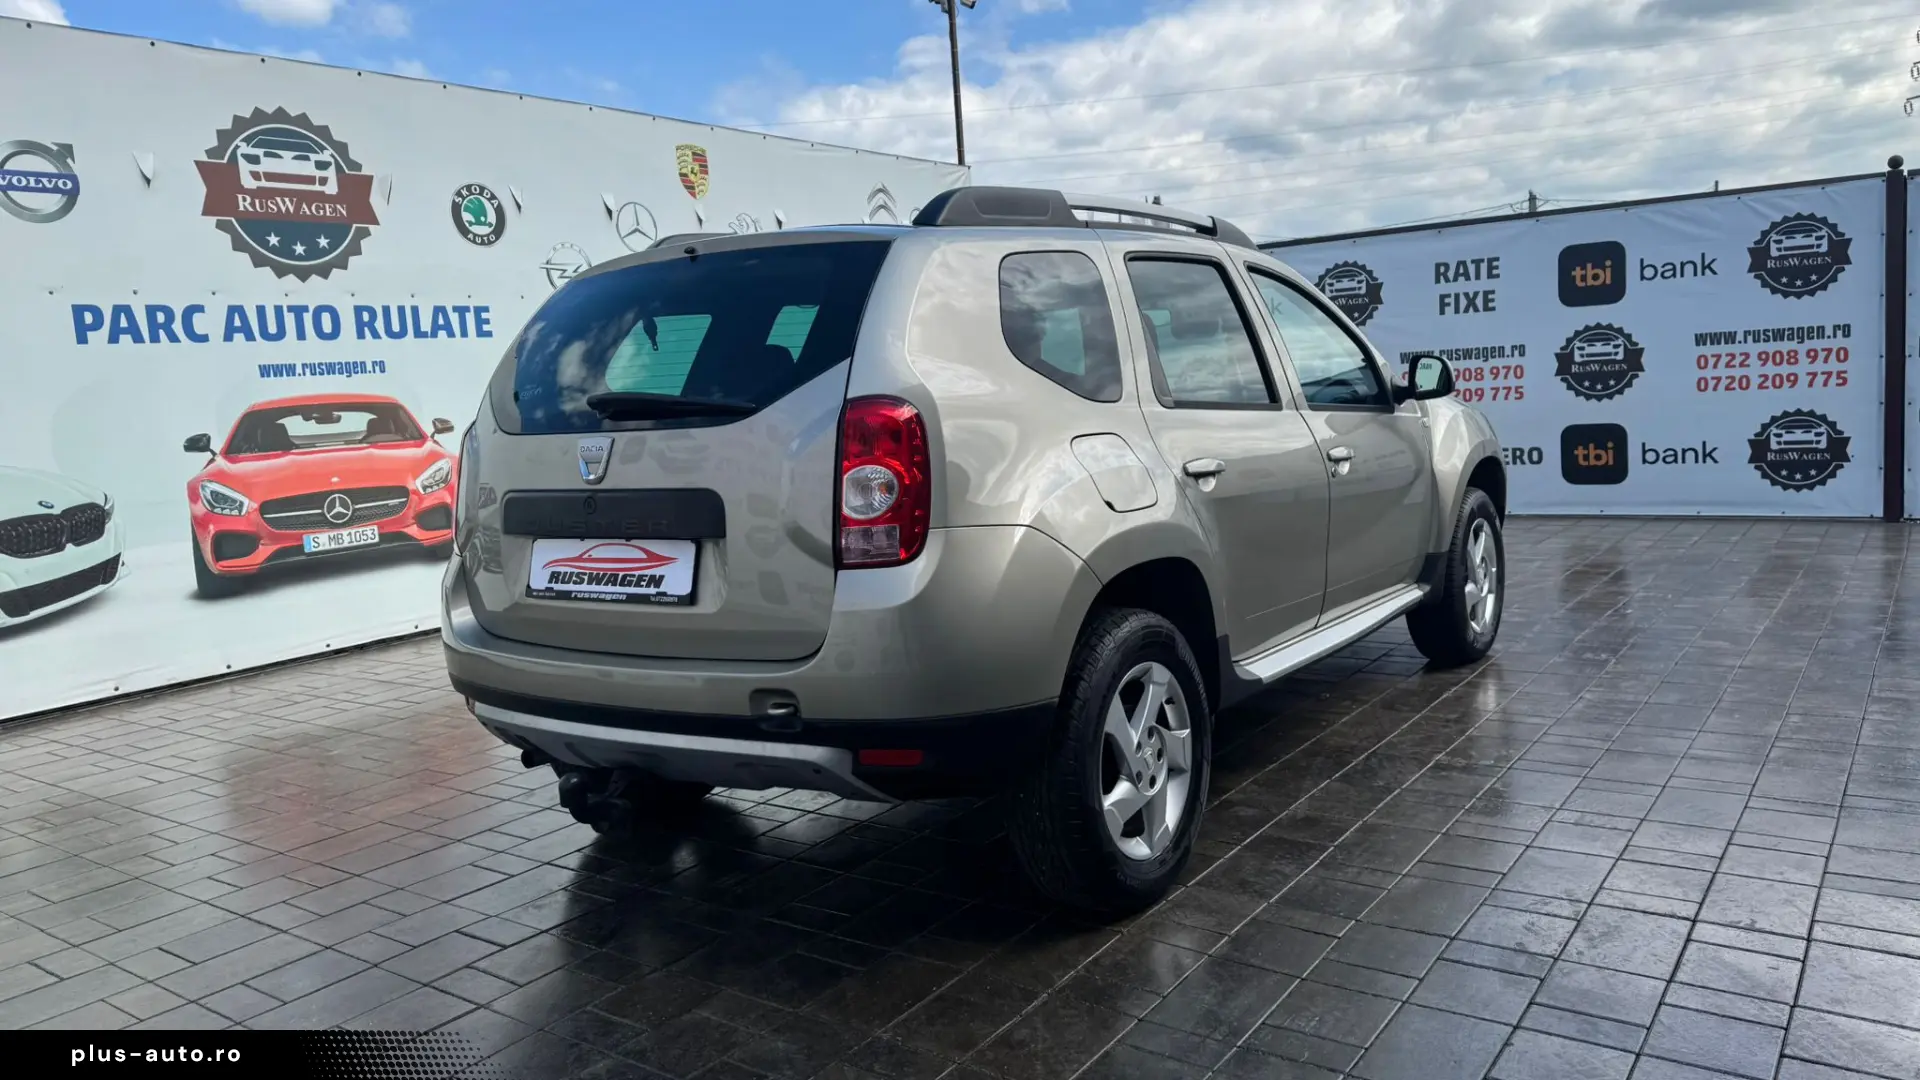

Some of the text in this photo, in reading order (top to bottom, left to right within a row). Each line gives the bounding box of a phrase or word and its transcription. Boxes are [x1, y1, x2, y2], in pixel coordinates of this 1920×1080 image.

[0, 174, 73, 190] VOLVO
[467, 233, 496, 243] AUTO
[1434, 256, 1501, 285] RATE
[1571, 252, 1719, 287] tbi bank
[1438, 289, 1497, 316] FIXE
[71, 303, 494, 345] PARC AUTO RULATE
[1694, 323, 1851, 347] www.ruswagen.ro
[1695, 346, 1849, 370] 0722 908 970
[258, 359, 387, 379] www.ruswagen.ro
[1489, 364, 1525, 381] 970
[1695, 370, 1849, 393] 0720 209 775
[1490, 386, 1525, 401] 775
[1502, 446, 1544, 466] ERO
[1574, 440, 1719, 466] tbi bank
[312, 528, 376, 549] S MB 1053
[548, 570, 666, 589] RUSWAGEN
[571, 591, 628, 601] ruswagen
